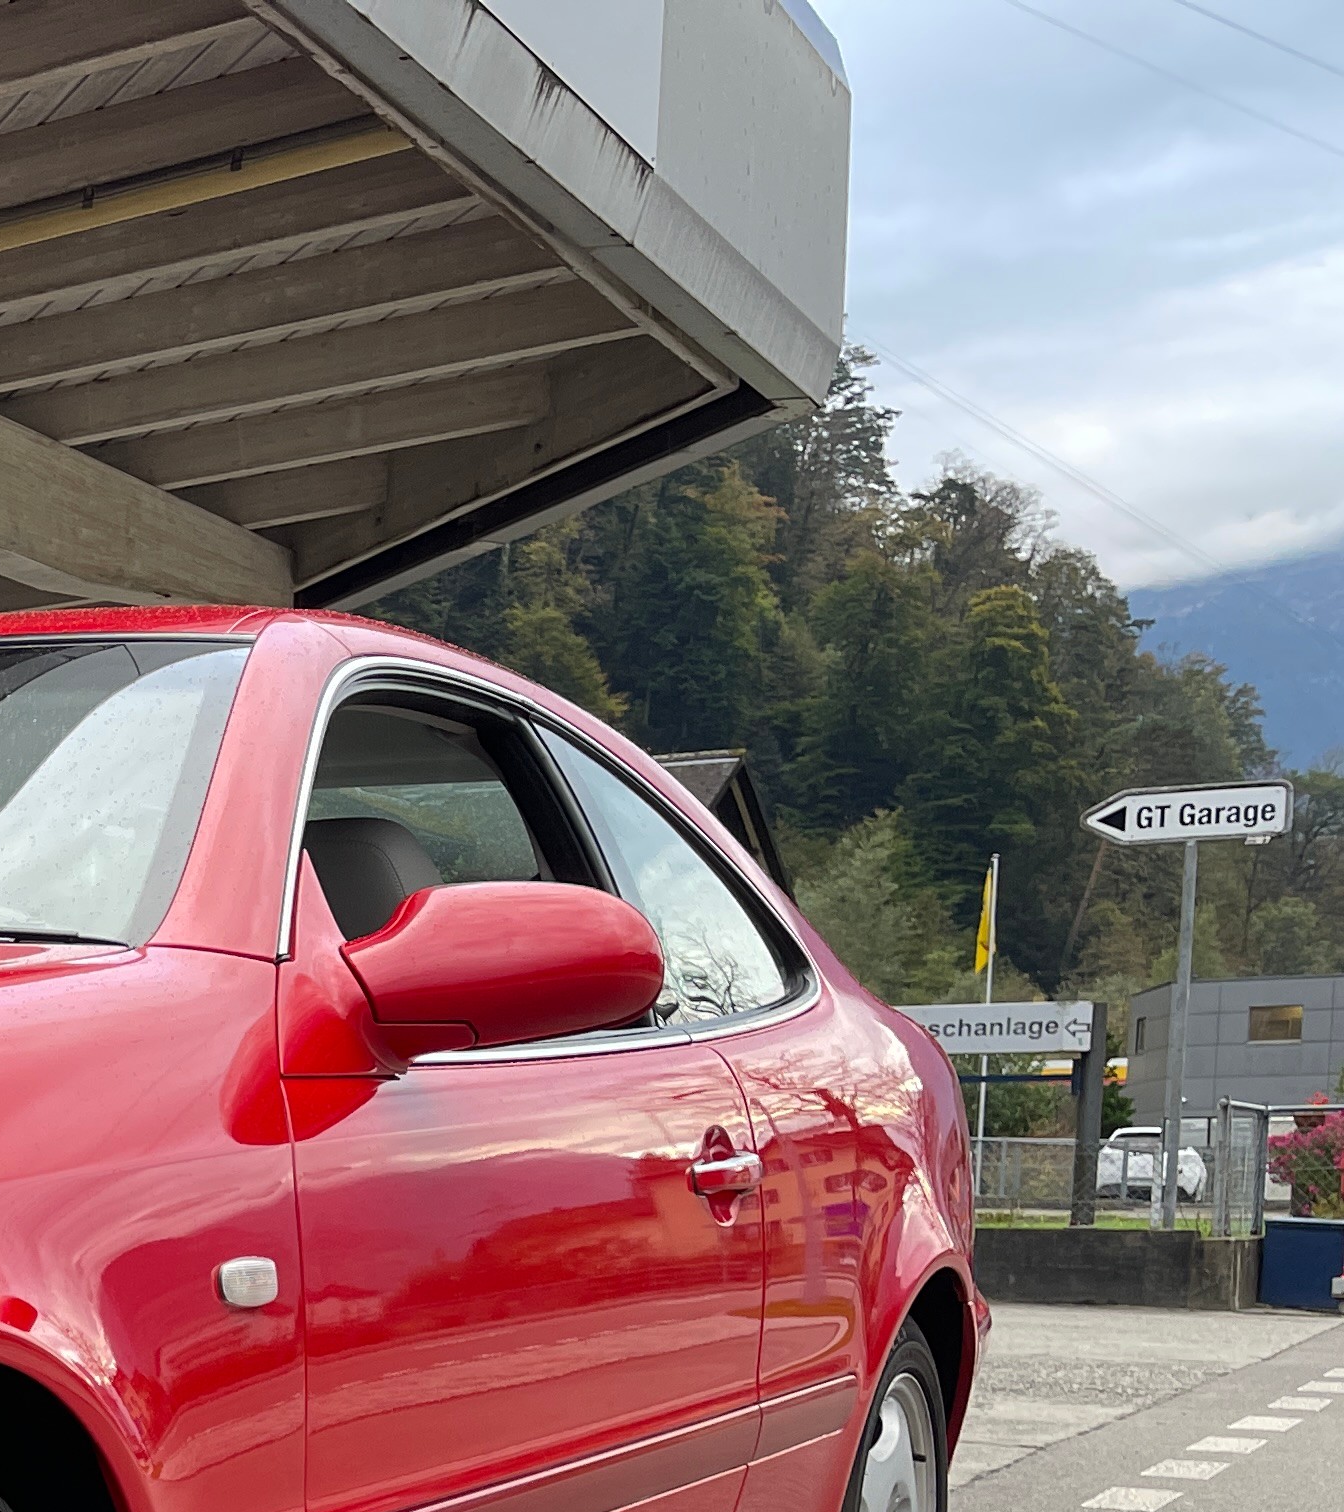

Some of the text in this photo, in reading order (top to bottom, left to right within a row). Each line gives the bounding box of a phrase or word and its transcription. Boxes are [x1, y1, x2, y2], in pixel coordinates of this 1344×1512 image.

[1136, 803, 1276, 829] GT Garage
[921, 1017, 1059, 1040] schanlage
